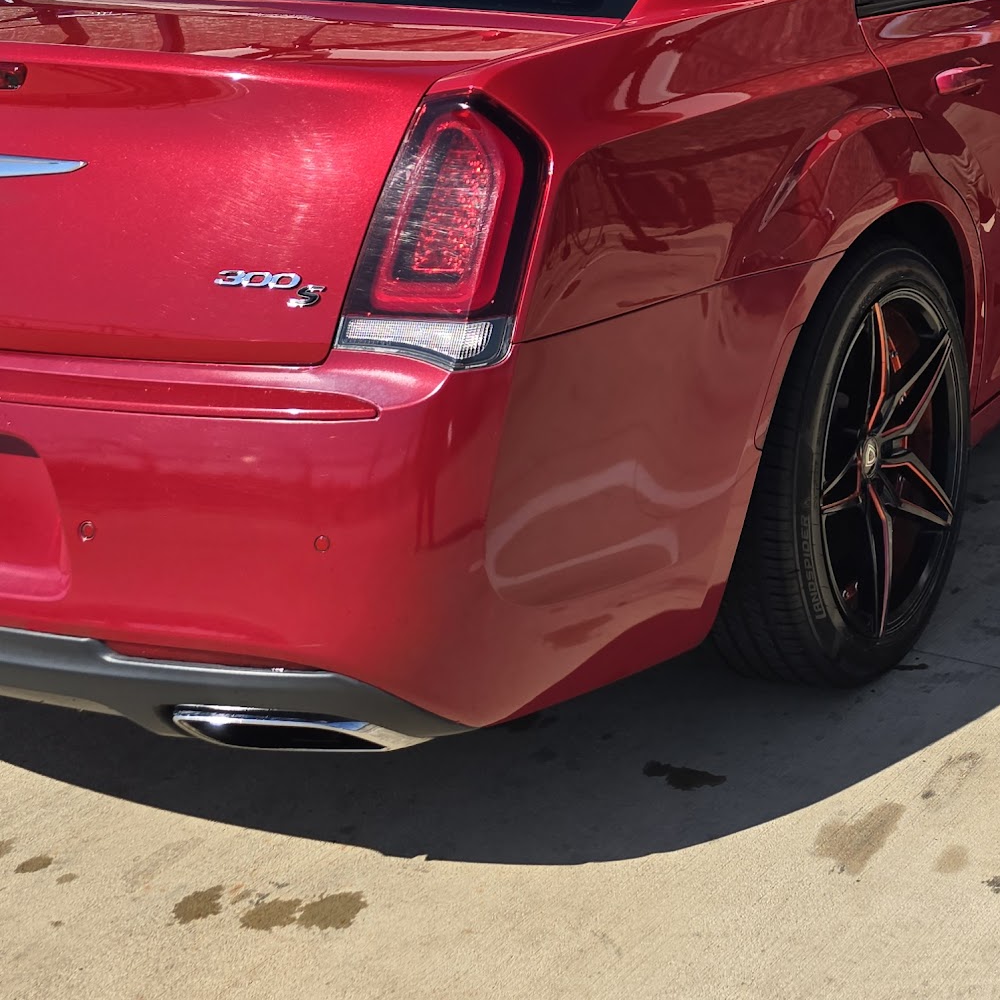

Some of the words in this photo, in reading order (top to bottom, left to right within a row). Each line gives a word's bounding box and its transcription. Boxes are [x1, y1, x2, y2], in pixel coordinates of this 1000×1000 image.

[214, 270, 301, 289] 300
[286, 284, 326, 308] S
[800, 515, 827, 620] LANDSPIDER
